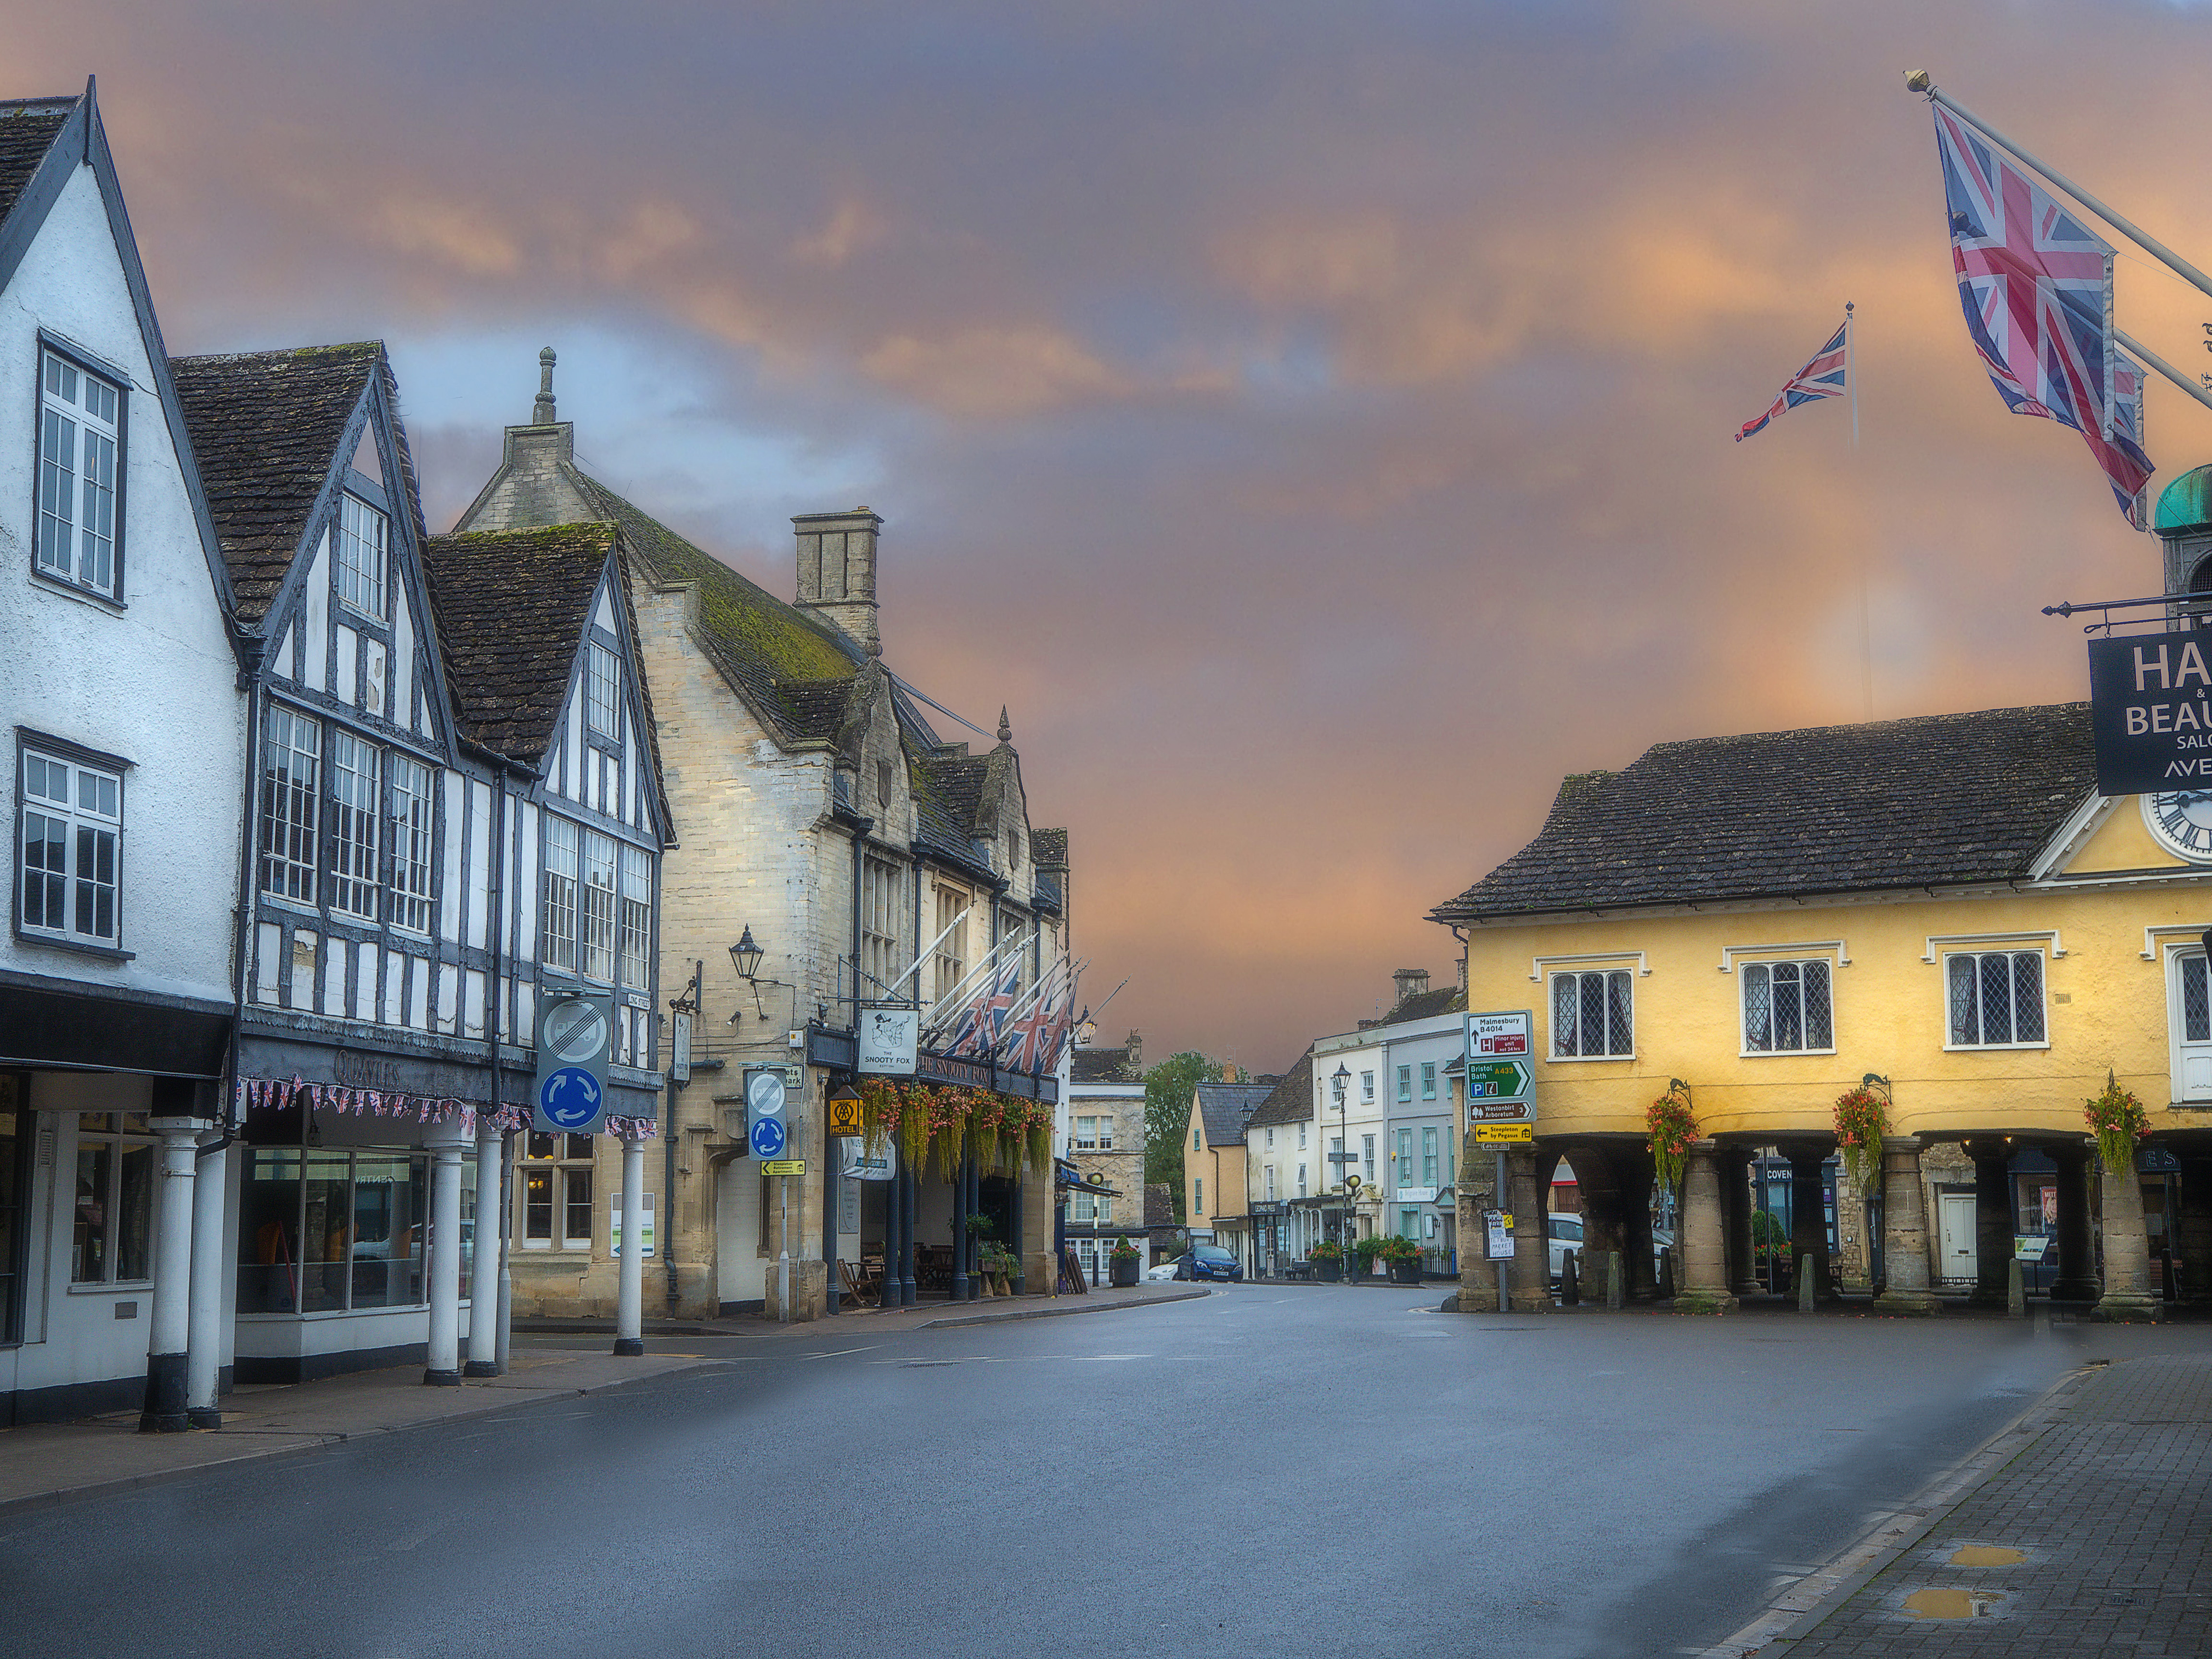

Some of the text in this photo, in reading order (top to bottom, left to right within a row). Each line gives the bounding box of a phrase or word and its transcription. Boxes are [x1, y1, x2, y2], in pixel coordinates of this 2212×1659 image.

[2197, 689, 2205, 698] &
[629, 996, 649, 1008] LONG STREET
[1482, 1039, 1491, 1051] H
[337, 1050, 400, 1085] QUAYLES
[937, 1059, 968, 1079] SNOOTY
[973, 1066, 989, 1082] FOX
[1474, 1084, 1482, 1095] P
[832, 1126, 856, 1134] HOTEL
[1255, 1204, 1275, 1213] LEOPARD PRESS
